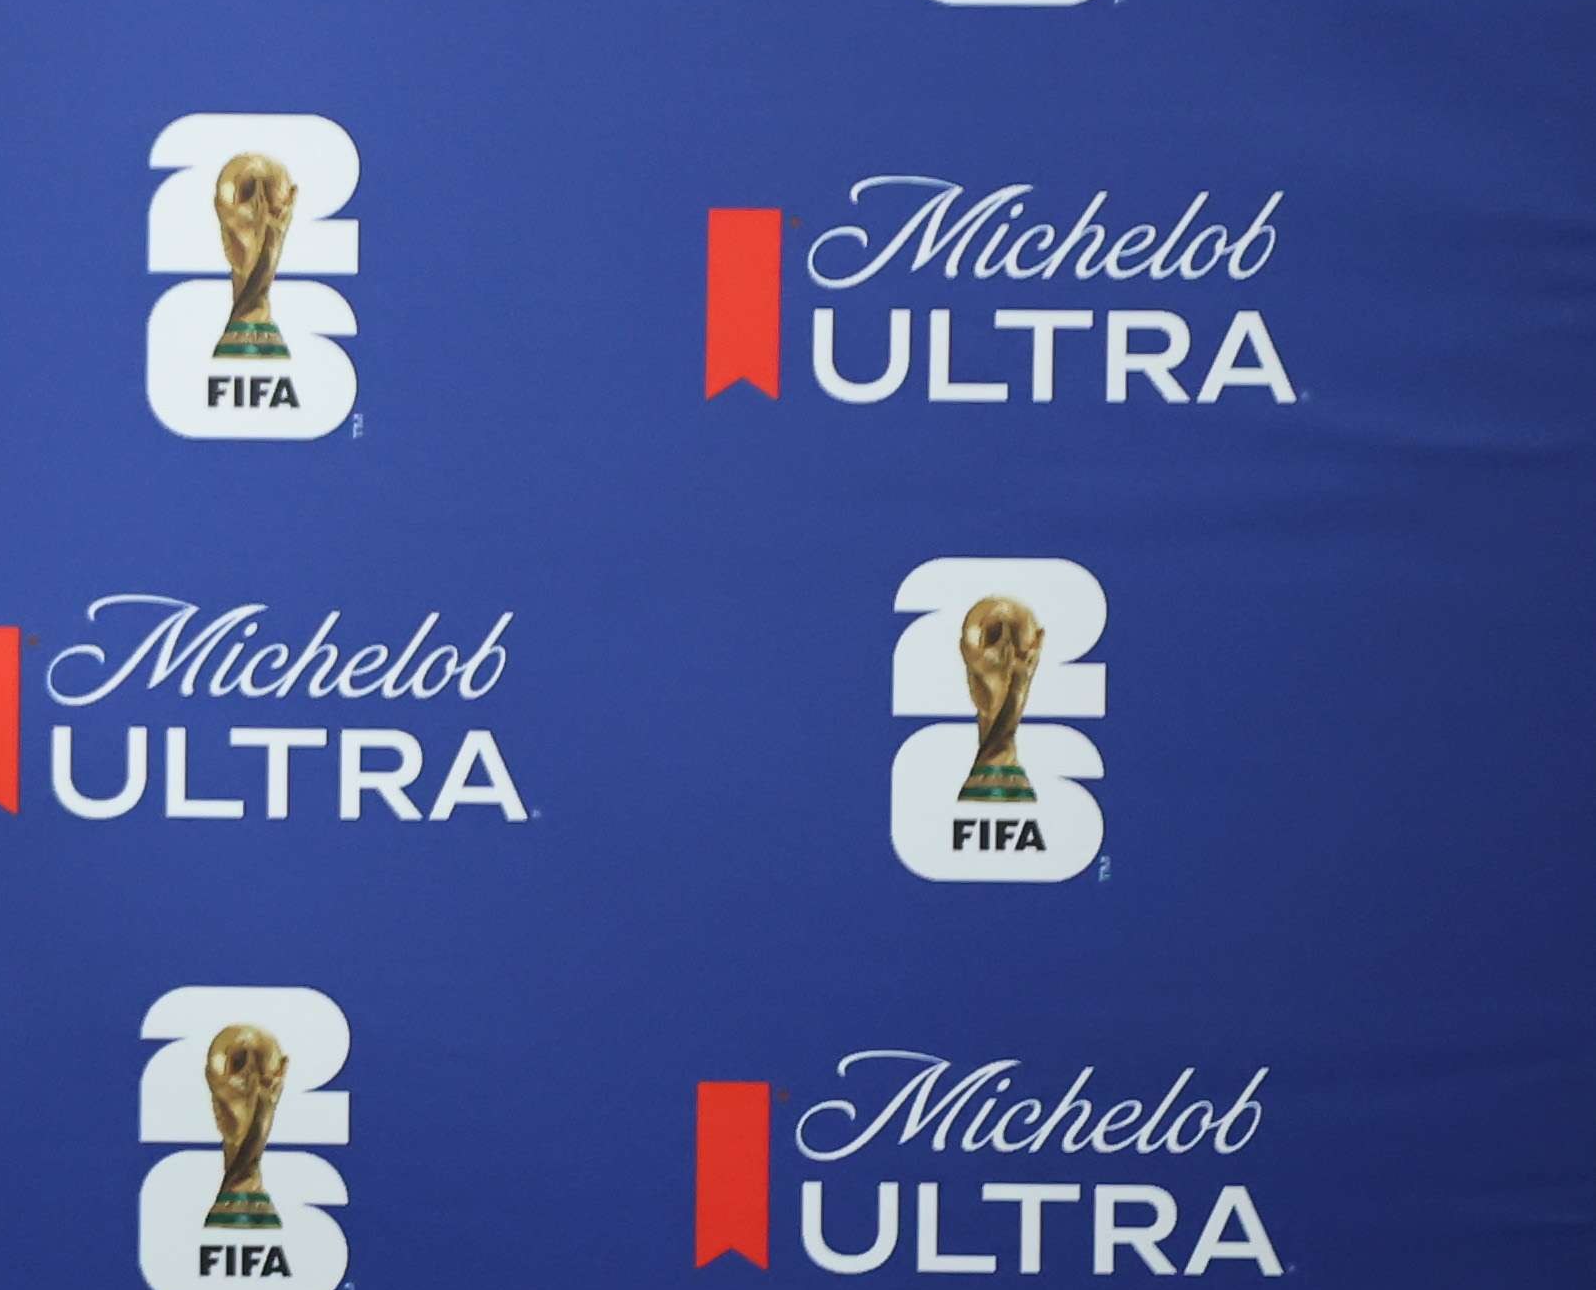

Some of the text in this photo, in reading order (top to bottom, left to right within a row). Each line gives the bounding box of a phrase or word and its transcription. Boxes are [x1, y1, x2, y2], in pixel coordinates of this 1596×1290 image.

[808, 176, 1283, 288] Michelob
[207, 376, 300, 409] FIFA
[813, 309, 1296, 403] ULTRA
[47, 594, 513, 706] Michelob
[51, 725, 528, 821] ULTRA
[952, 818, 1047, 852] FIFA
[796, 1050, 1268, 1161] Michelob
[199, 1244, 292, 1278] FIFA
[802, 1181, 1284, 1276] ULTRA
